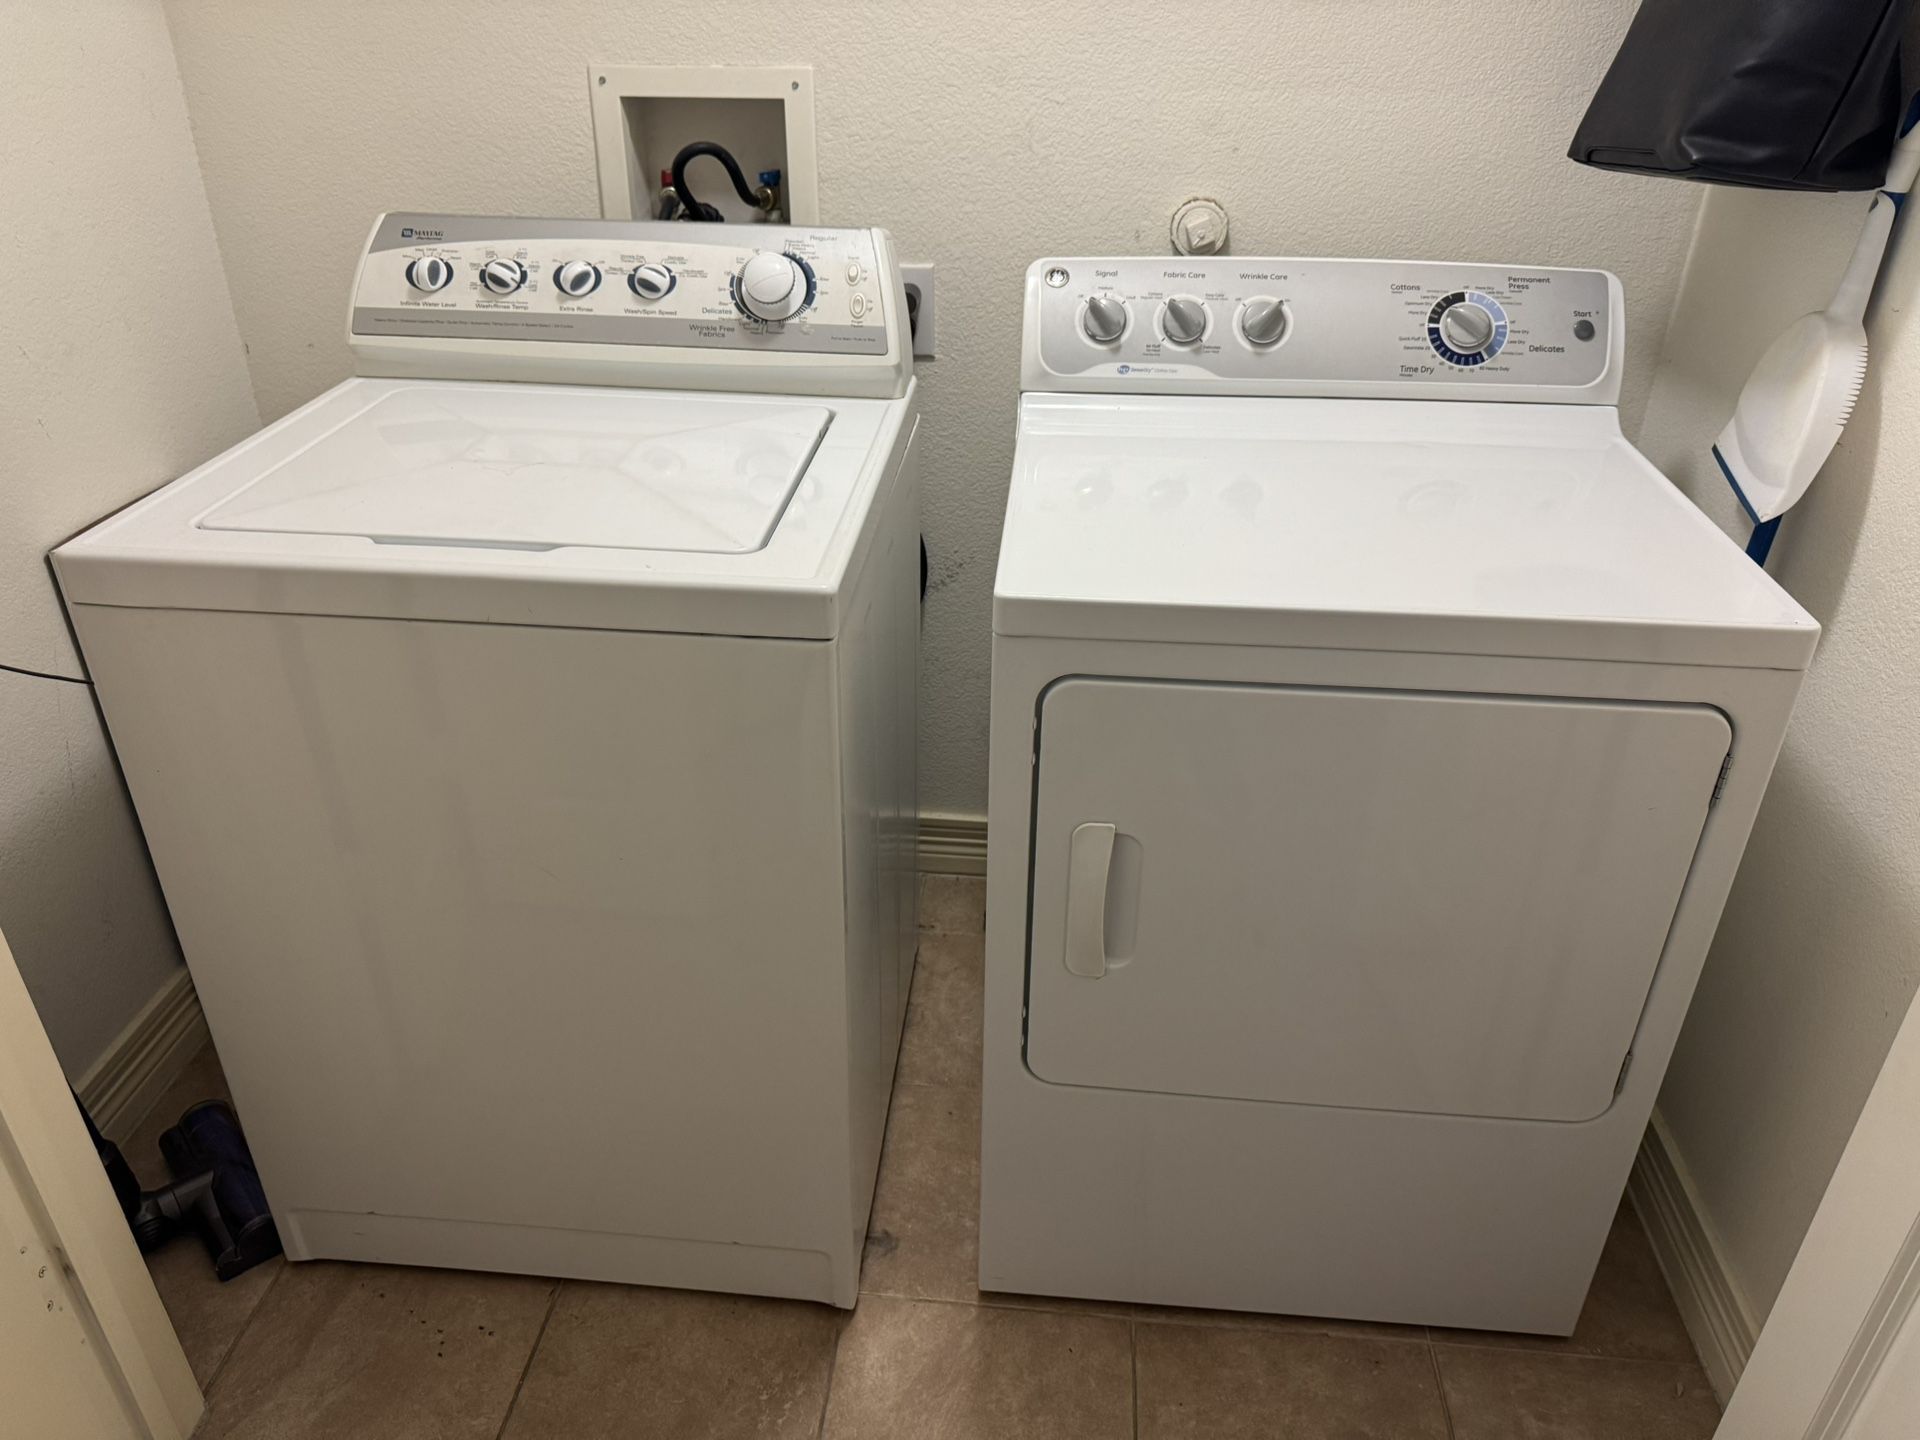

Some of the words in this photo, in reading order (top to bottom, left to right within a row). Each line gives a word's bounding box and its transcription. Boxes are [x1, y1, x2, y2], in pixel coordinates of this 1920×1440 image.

[1095, 270, 1118, 278] Signal
[1163, 271, 1186, 279] Fabric
[1187, 271, 1206, 279] Care
[1239, 272, 1268, 280] Wrinkle
[1508, 276, 1551, 284] Permanent
[1390, 283, 1421, 291] Cottons
[624, 308, 657, 316] Wash/Spin
[1573, 310, 1592, 318] Start
[689, 323, 718, 331] Wrinkle
[719, 324, 735, 332] Free
[698, 330, 726, 338] Fabrics
[1528, 344, 1566, 353] Delicates
[1400, 365, 1419, 373] Time
[1420, 365, 1435, 375] Dry
